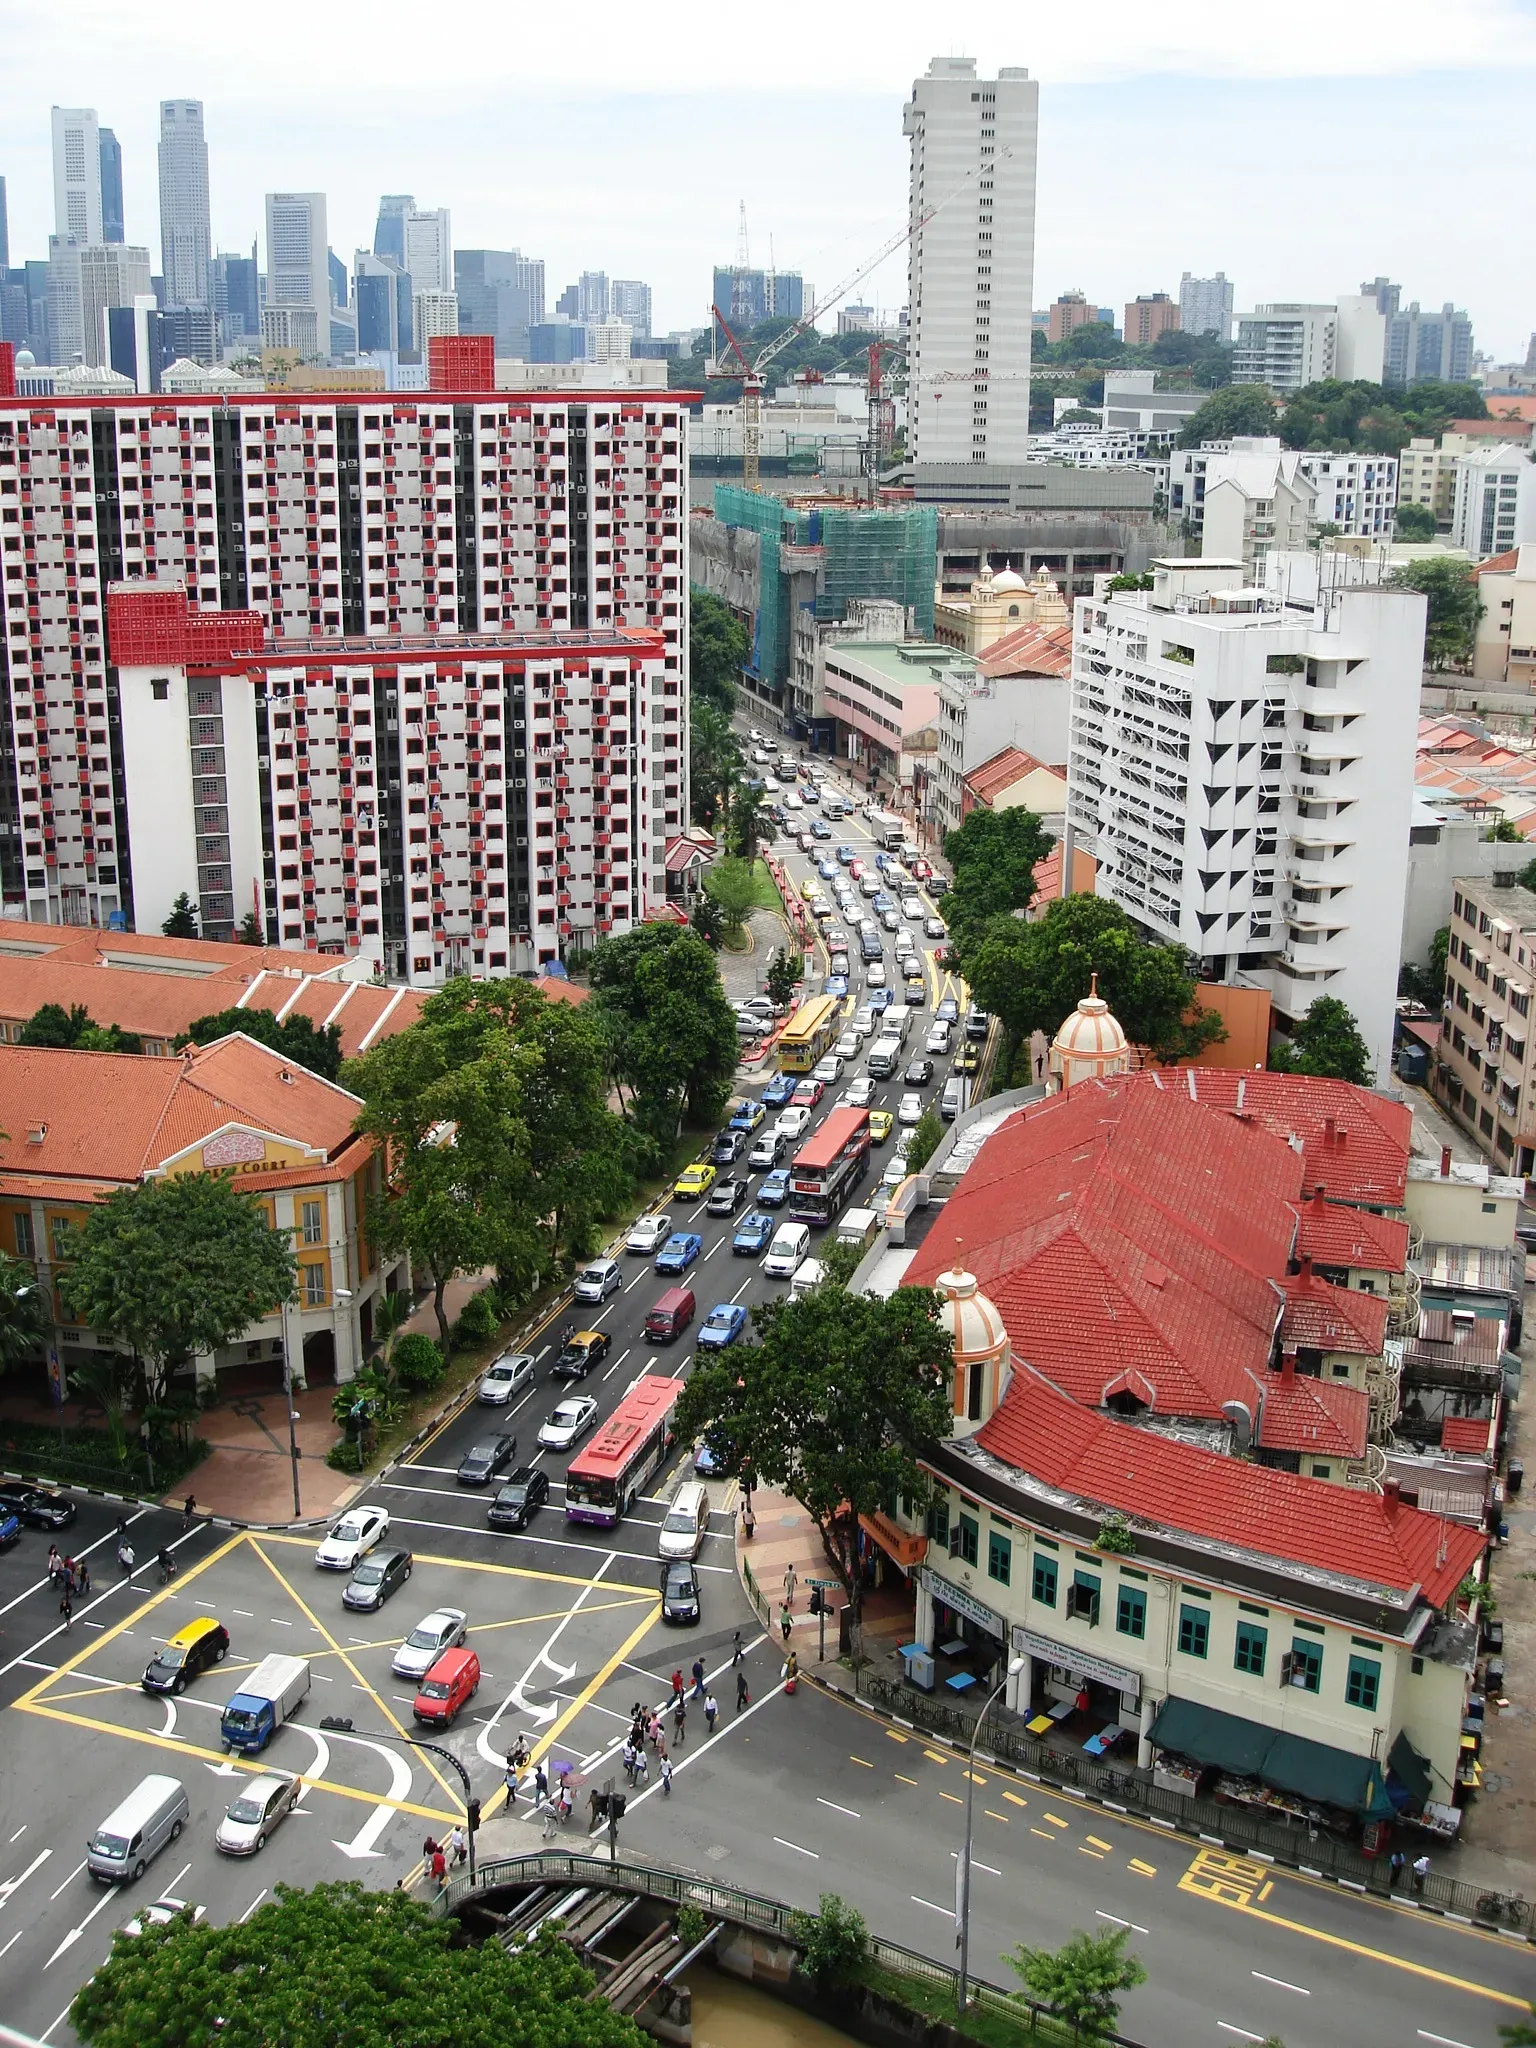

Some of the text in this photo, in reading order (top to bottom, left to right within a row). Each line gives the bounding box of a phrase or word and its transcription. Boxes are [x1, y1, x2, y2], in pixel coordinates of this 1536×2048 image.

[972, 1602, 993, 1620] VILAS
[1024, 1634, 1053, 1649] Vegetarian
[1098, 1660, 1128, 1676] Restaurant
